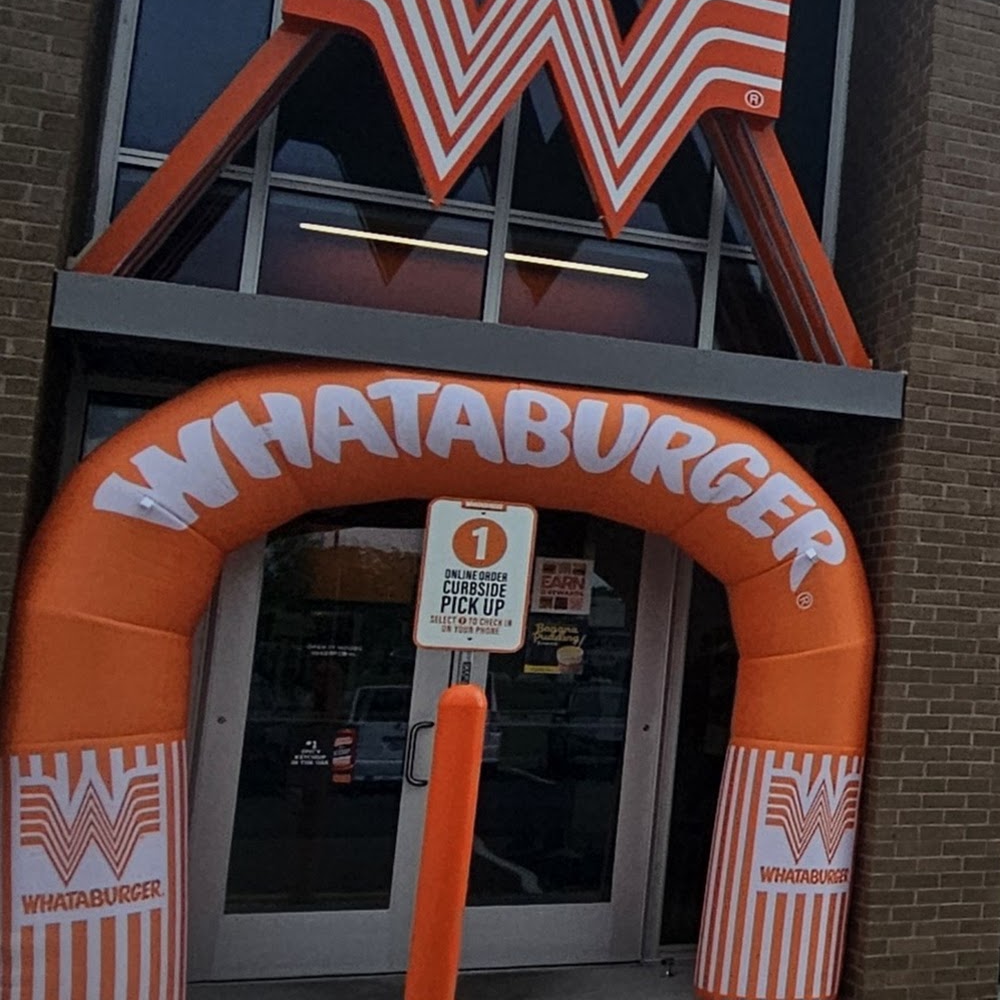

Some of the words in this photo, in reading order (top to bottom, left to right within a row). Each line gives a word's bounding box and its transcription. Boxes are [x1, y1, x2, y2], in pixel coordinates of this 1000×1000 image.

[93, 379, 846, 592] WHATABURGER
[472, 526, 488, 560] 1
[444, 568, 478, 580] ONLINE
[479, 570, 508, 582] ORDER
[541, 575, 586, 590] EARN
[443, 580, 507, 598] CURBSIDE
[440, 595, 480, 615] PICK
[483, 598, 505, 616] UP
[430, 615, 457, 625] SELECT
[468, 617, 478, 625] TO
[479, 618, 503, 628] CHECK
[454, 626, 474, 635] YOUR
[476, 627, 500, 636] PHONE
[760, 865, 849, 886] WHATABURGER
[22, 878, 162, 914] WHATABURGER
